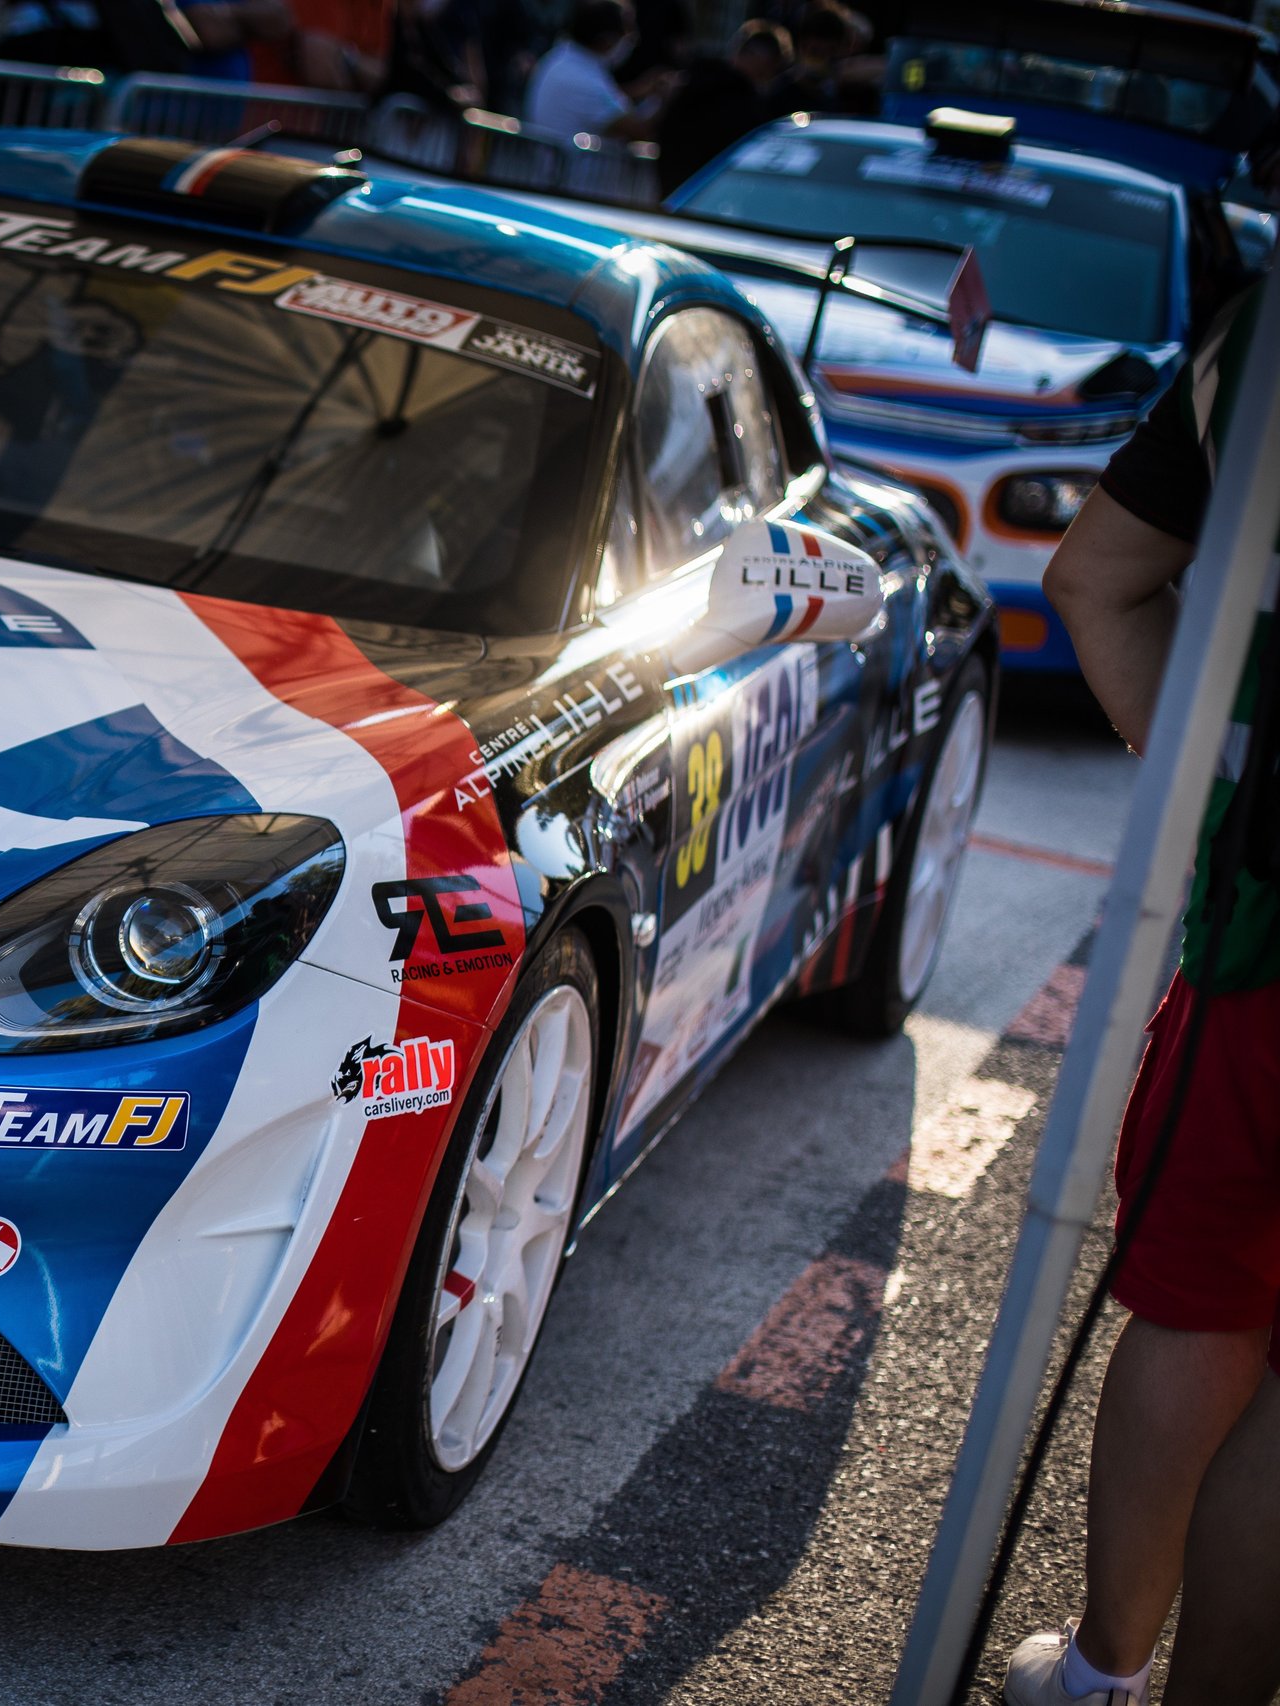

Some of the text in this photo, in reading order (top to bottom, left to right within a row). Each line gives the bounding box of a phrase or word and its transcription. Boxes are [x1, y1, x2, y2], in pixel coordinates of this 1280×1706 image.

[742, 565, 865, 595] LILLE
[529, 661, 645, 750] LILLE
[469, 721, 531, 766] CENTRE
[453, 742, 546, 813] ALPINE
[391, 952, 514, 984] RACING & EMOTION
[361, 1041, 454, 1099] rally
[364, 1089, 450, 1117] carslivery.com
